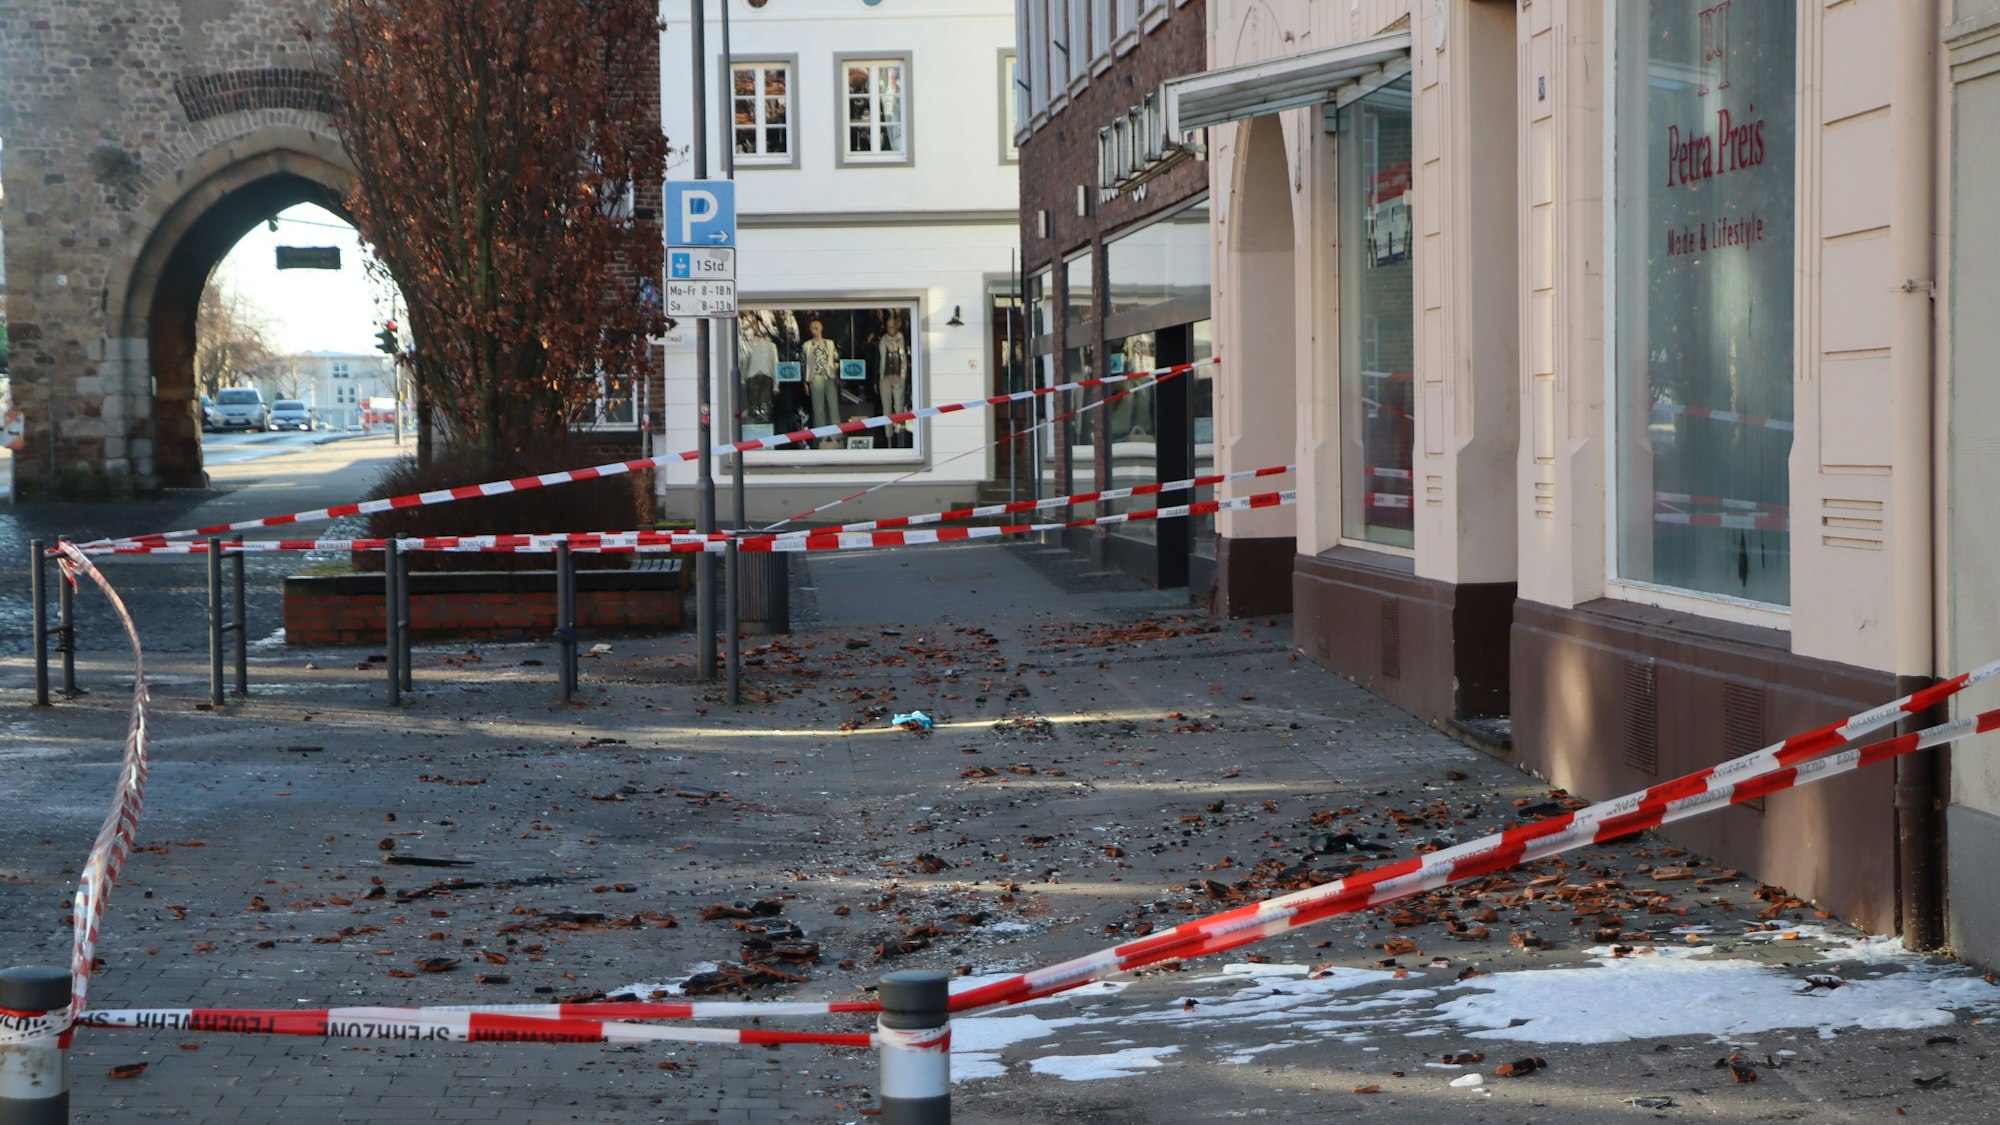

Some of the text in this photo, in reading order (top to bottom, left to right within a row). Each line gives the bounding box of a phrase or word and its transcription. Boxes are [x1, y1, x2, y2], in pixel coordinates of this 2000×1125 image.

[1667, 104, 1765, 188] Petra Preis
[681, 190, 719, 243] P
[1667, 211, 1763, 257] Mode & Lifestyle
[696, 260, 701, 272] 1
[670, 286, 696, 296] Mo-Fr
[136, 1011, 276, 1034] FEUERWEHR
